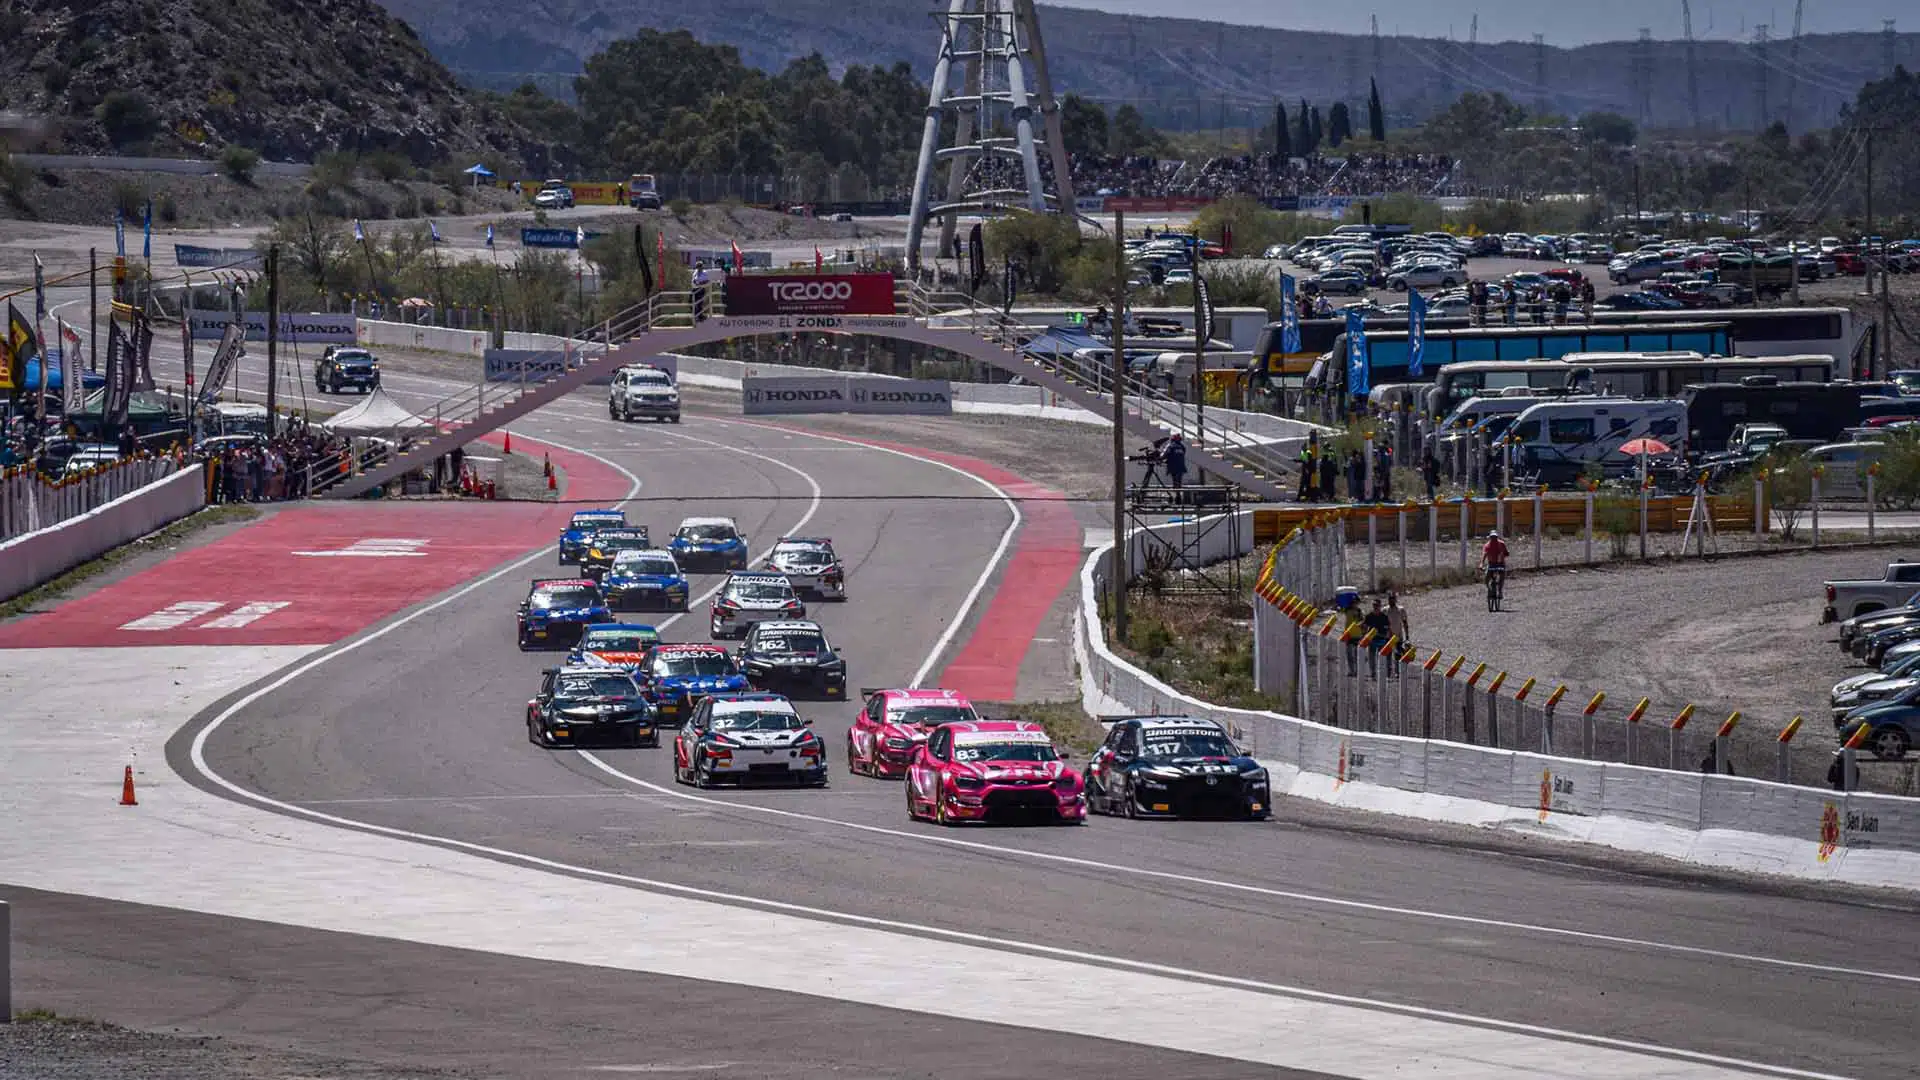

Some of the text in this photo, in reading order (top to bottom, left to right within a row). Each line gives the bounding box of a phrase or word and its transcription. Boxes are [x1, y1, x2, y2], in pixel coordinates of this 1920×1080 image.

[768, 281, 852, 301] TC2000
[779, 318, 792, 328] EL
[797, 316, 842, 328] ZONDA
[291, 323, 353, 335] HONDA
[766, 389, 843, 402] HONDA
[871, 391, 946, 403] HONDA
[732, 575, 787, 584] MENDOZA
[758, 640, 786, 650] 162
[714, 718, 736, 729] 32
[1145, 728, 1222, 738] BRIDGESTONE
[956, 748, 980, 761] 83
[1148, 741, 1181, 756] 117
[1183, 764, 1239, 774] YPF
